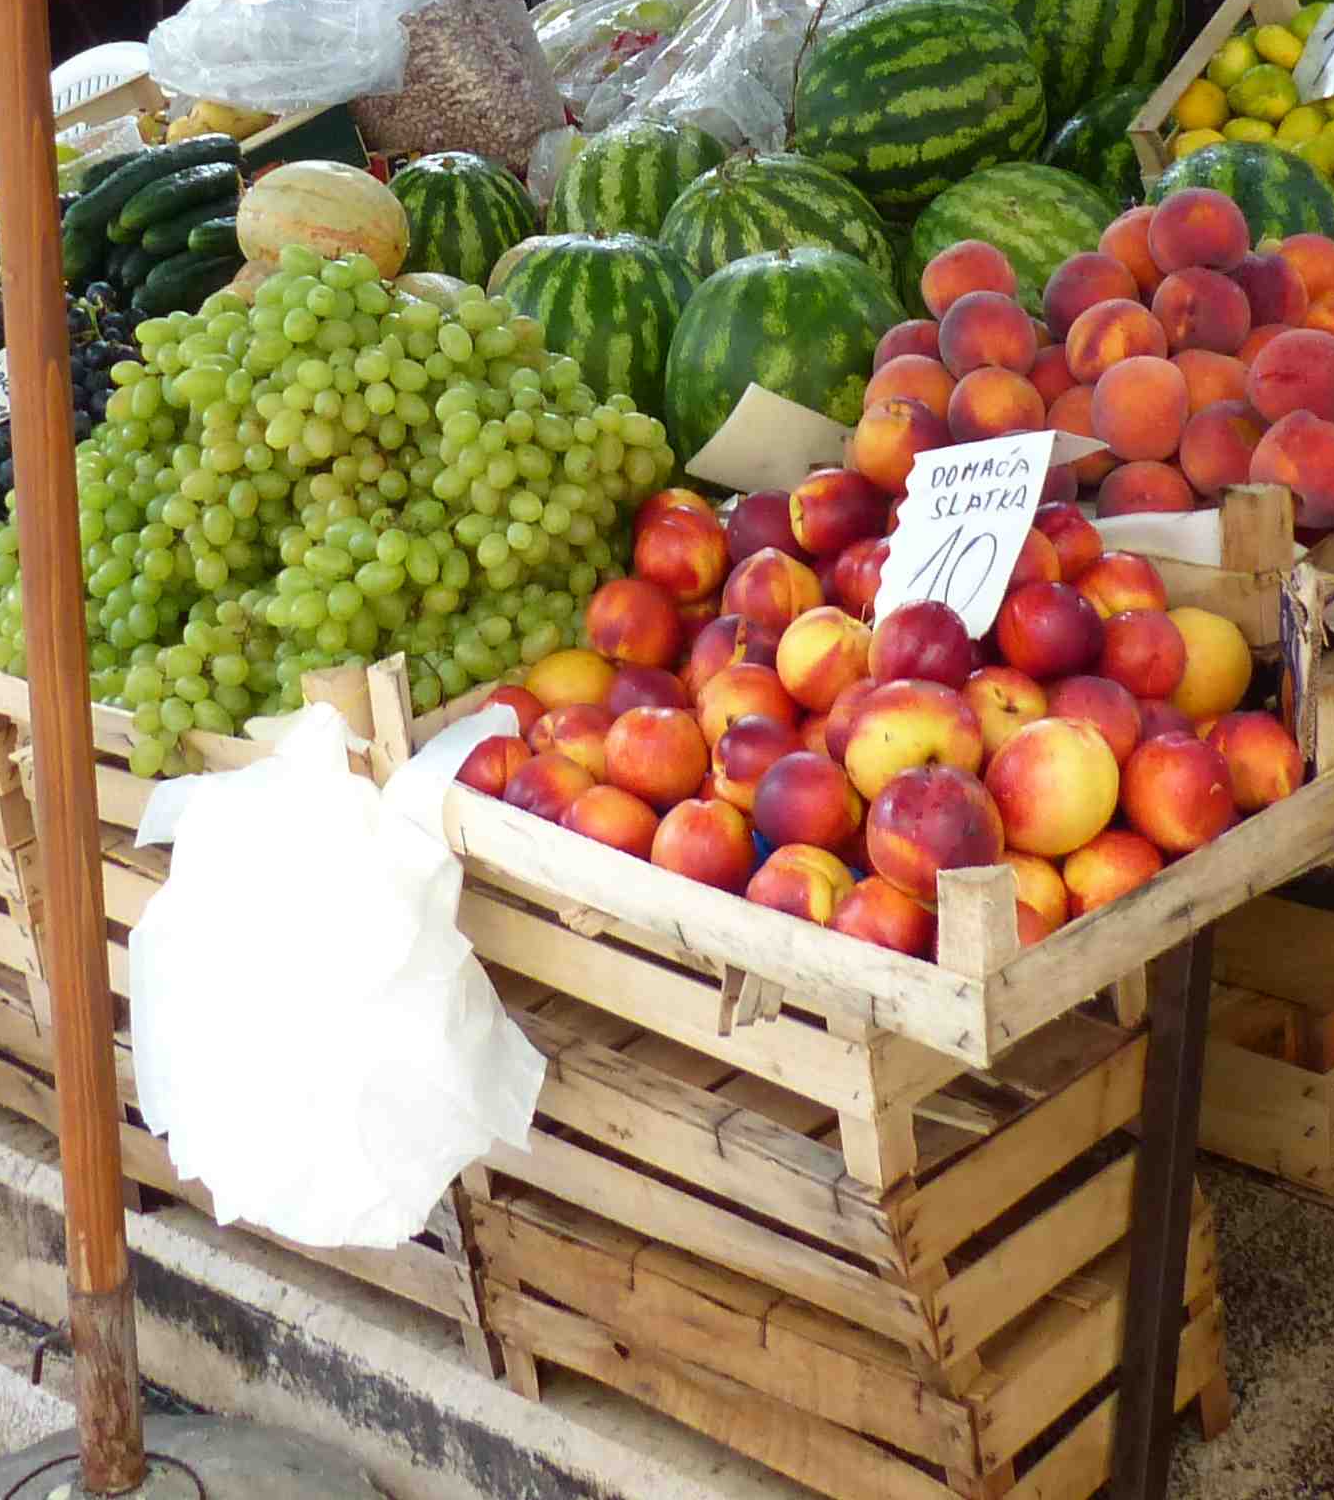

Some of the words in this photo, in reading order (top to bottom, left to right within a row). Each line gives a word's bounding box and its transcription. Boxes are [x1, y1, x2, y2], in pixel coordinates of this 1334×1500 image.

[930, 446, 1030, 489] DOMAĆA
[929, 484, 1028, 521] SLATKA
[906, 523, 998, 613] 10
